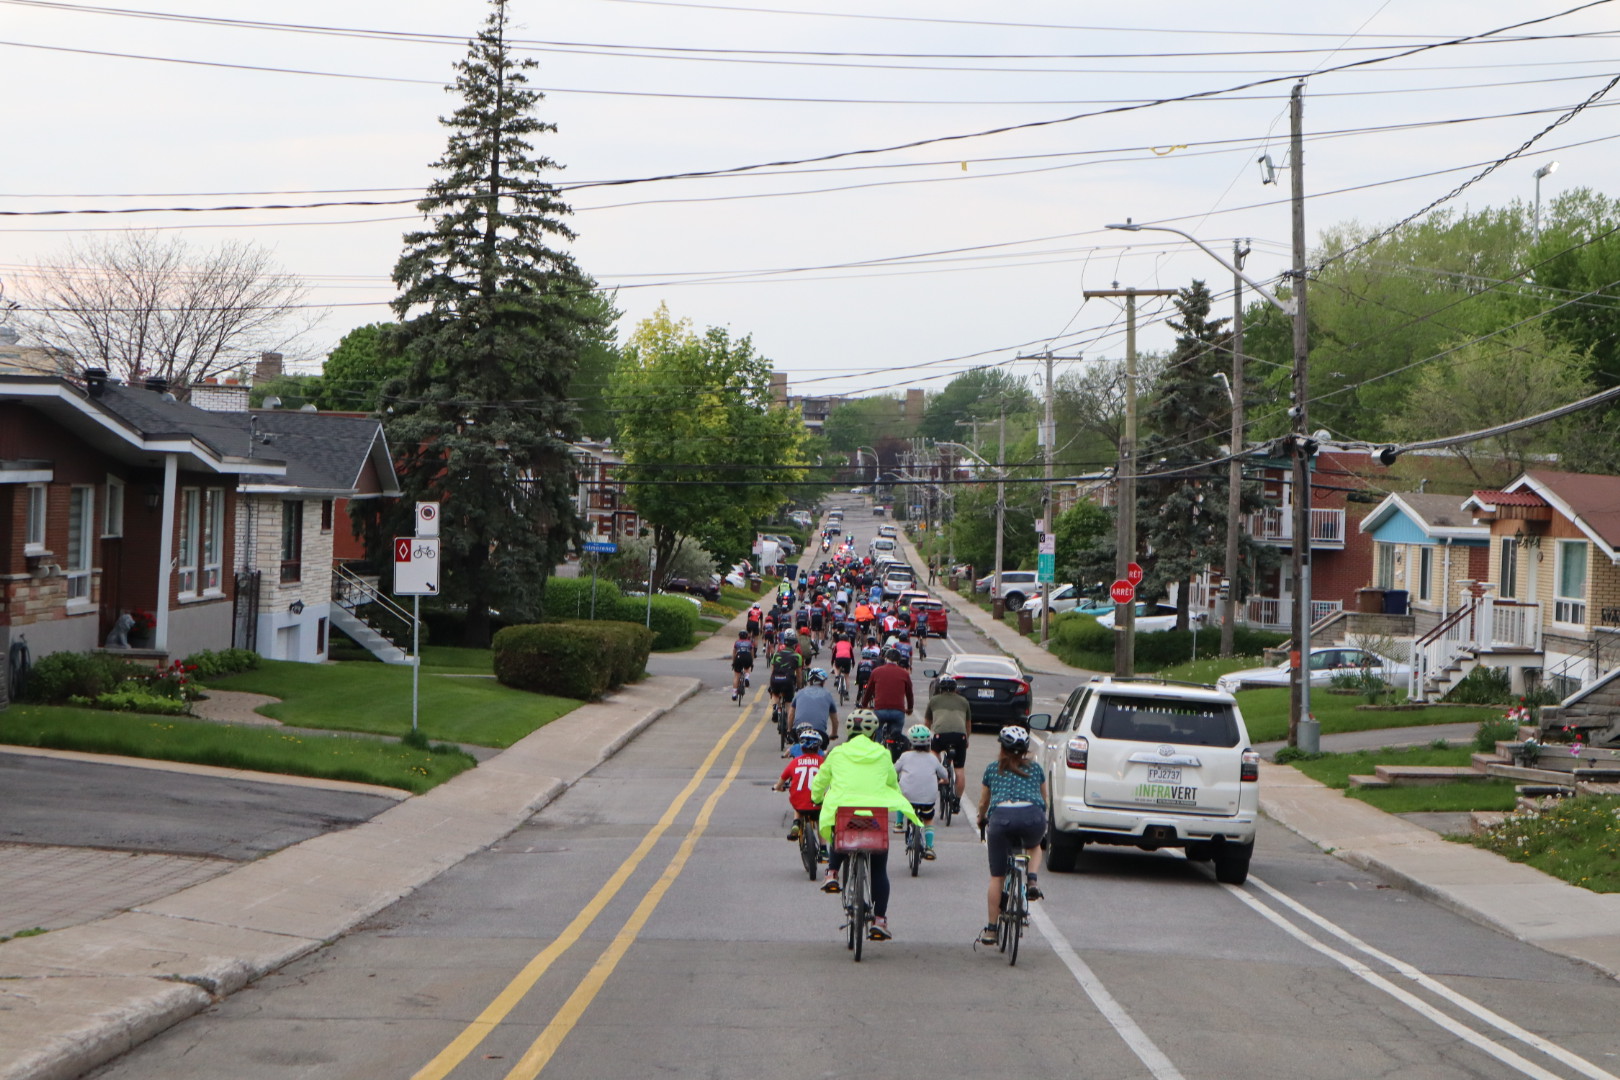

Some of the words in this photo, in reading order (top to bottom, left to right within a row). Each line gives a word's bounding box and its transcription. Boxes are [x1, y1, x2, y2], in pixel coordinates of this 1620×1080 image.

[1128, 570, 1141, 578] RÊT
[1111, 587, 1133, 596] ARRÊT
[1149, 769, 1180, 780] FPJ2737
[1139, 783, 1198, 800] INFRAVERT
